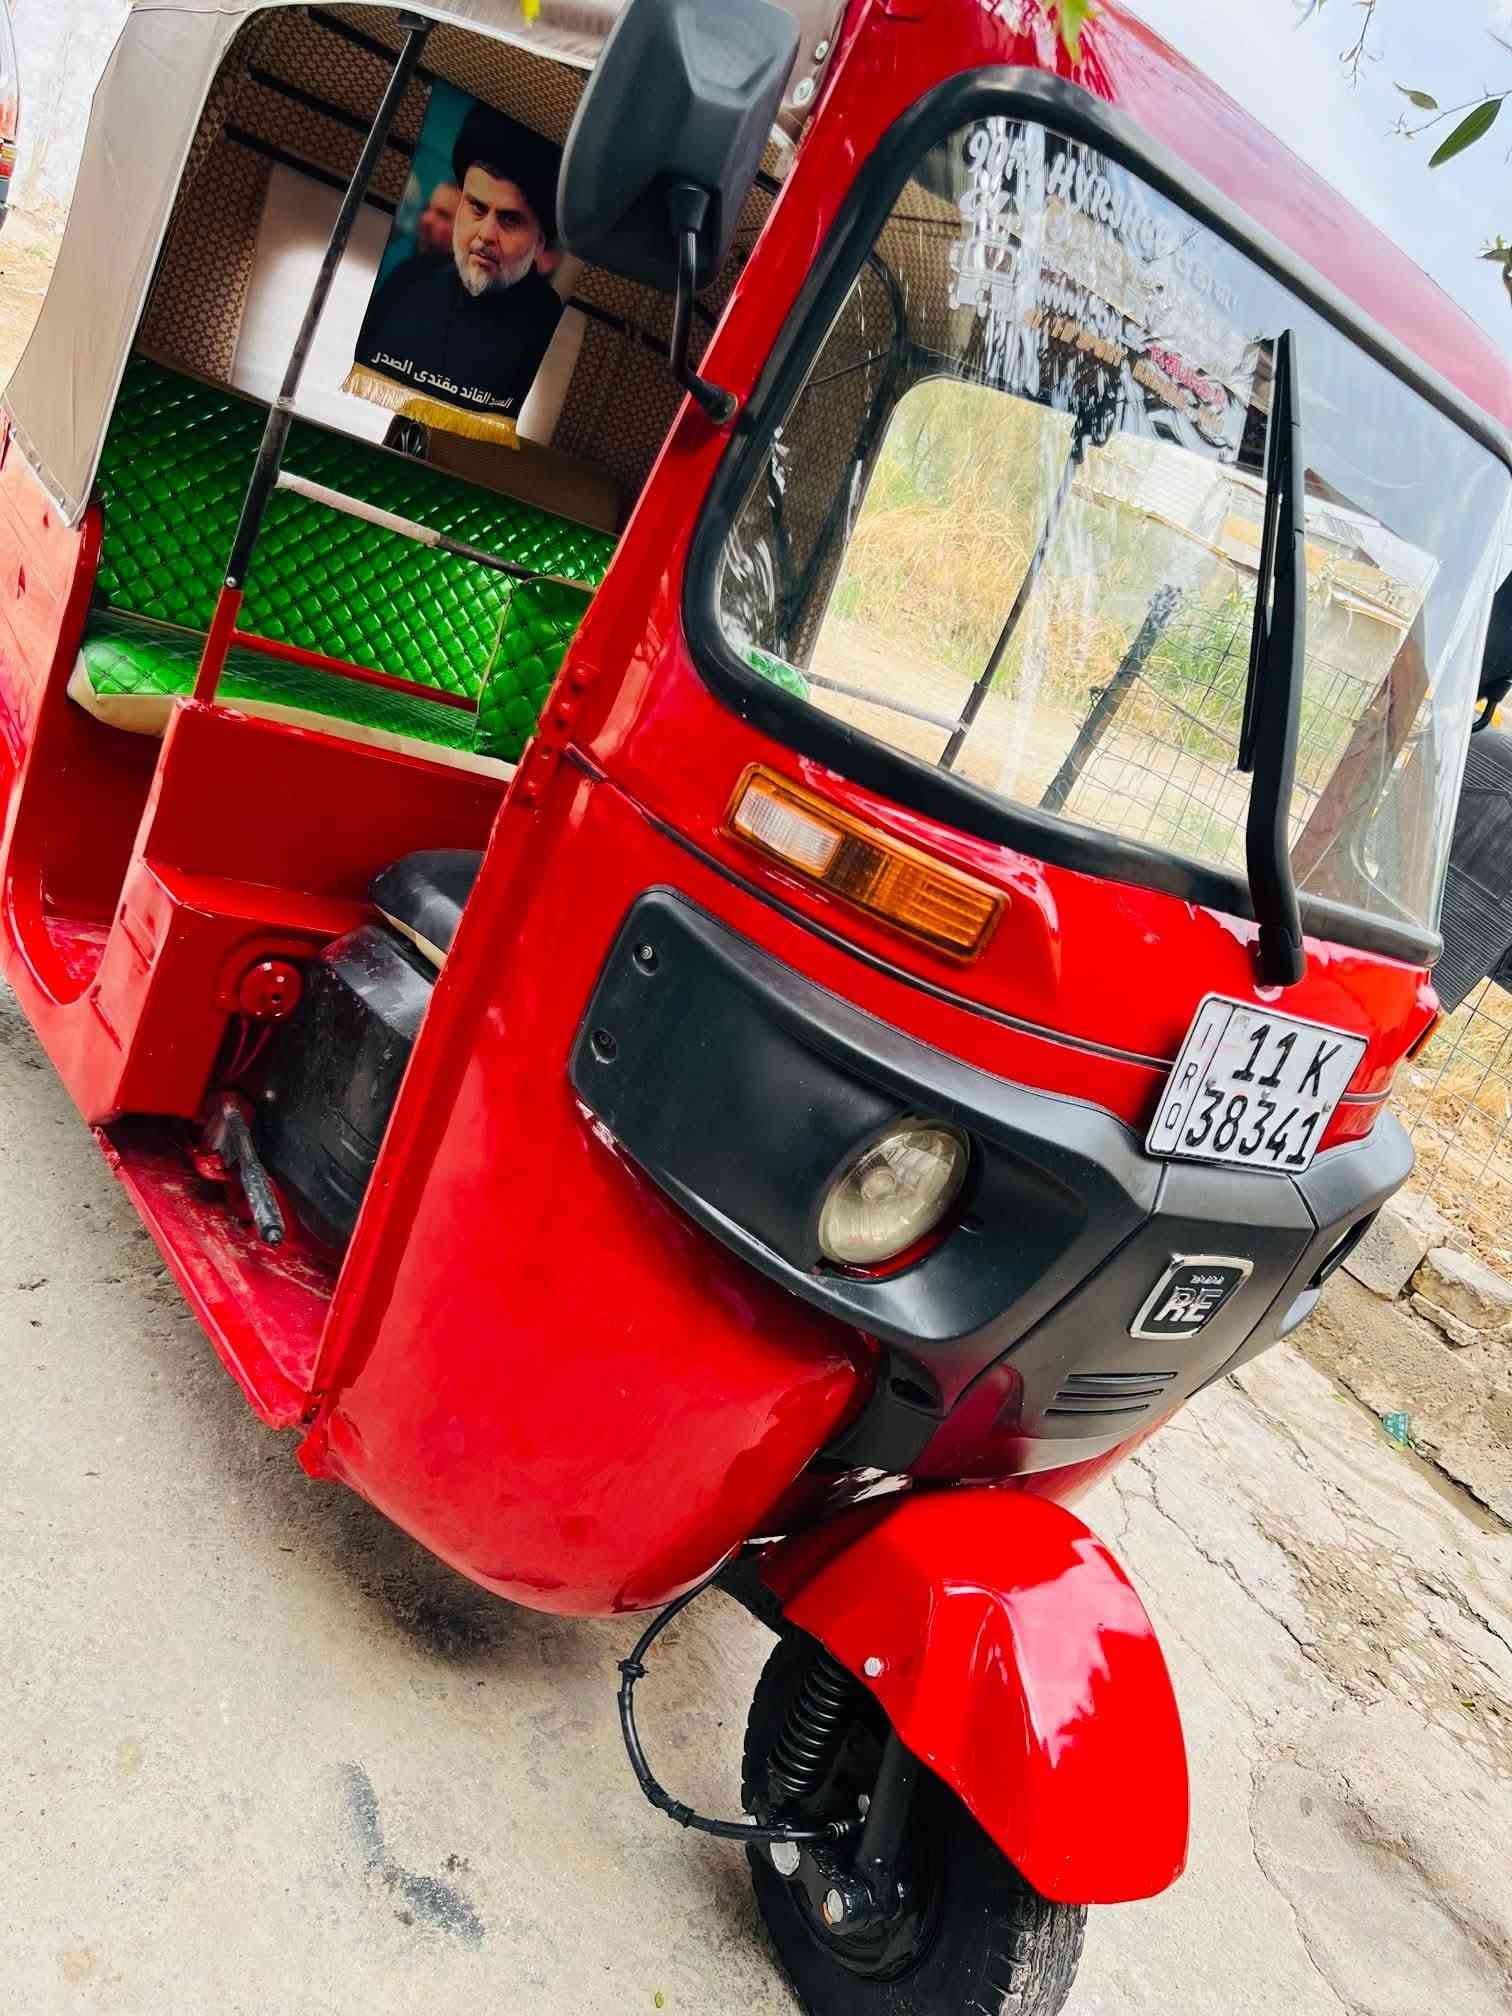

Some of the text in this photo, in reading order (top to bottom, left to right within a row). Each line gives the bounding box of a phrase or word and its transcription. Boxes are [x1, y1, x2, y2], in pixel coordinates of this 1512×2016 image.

[370, 351, 413, 375] الصدر
[413, 369, 459, 395] مقتدى
[1231, 1023, 1343, 1098] 11 K
[1184, 1088, 1321, 1165] 38341
[1153, 1286, 1224, 1322] RE
